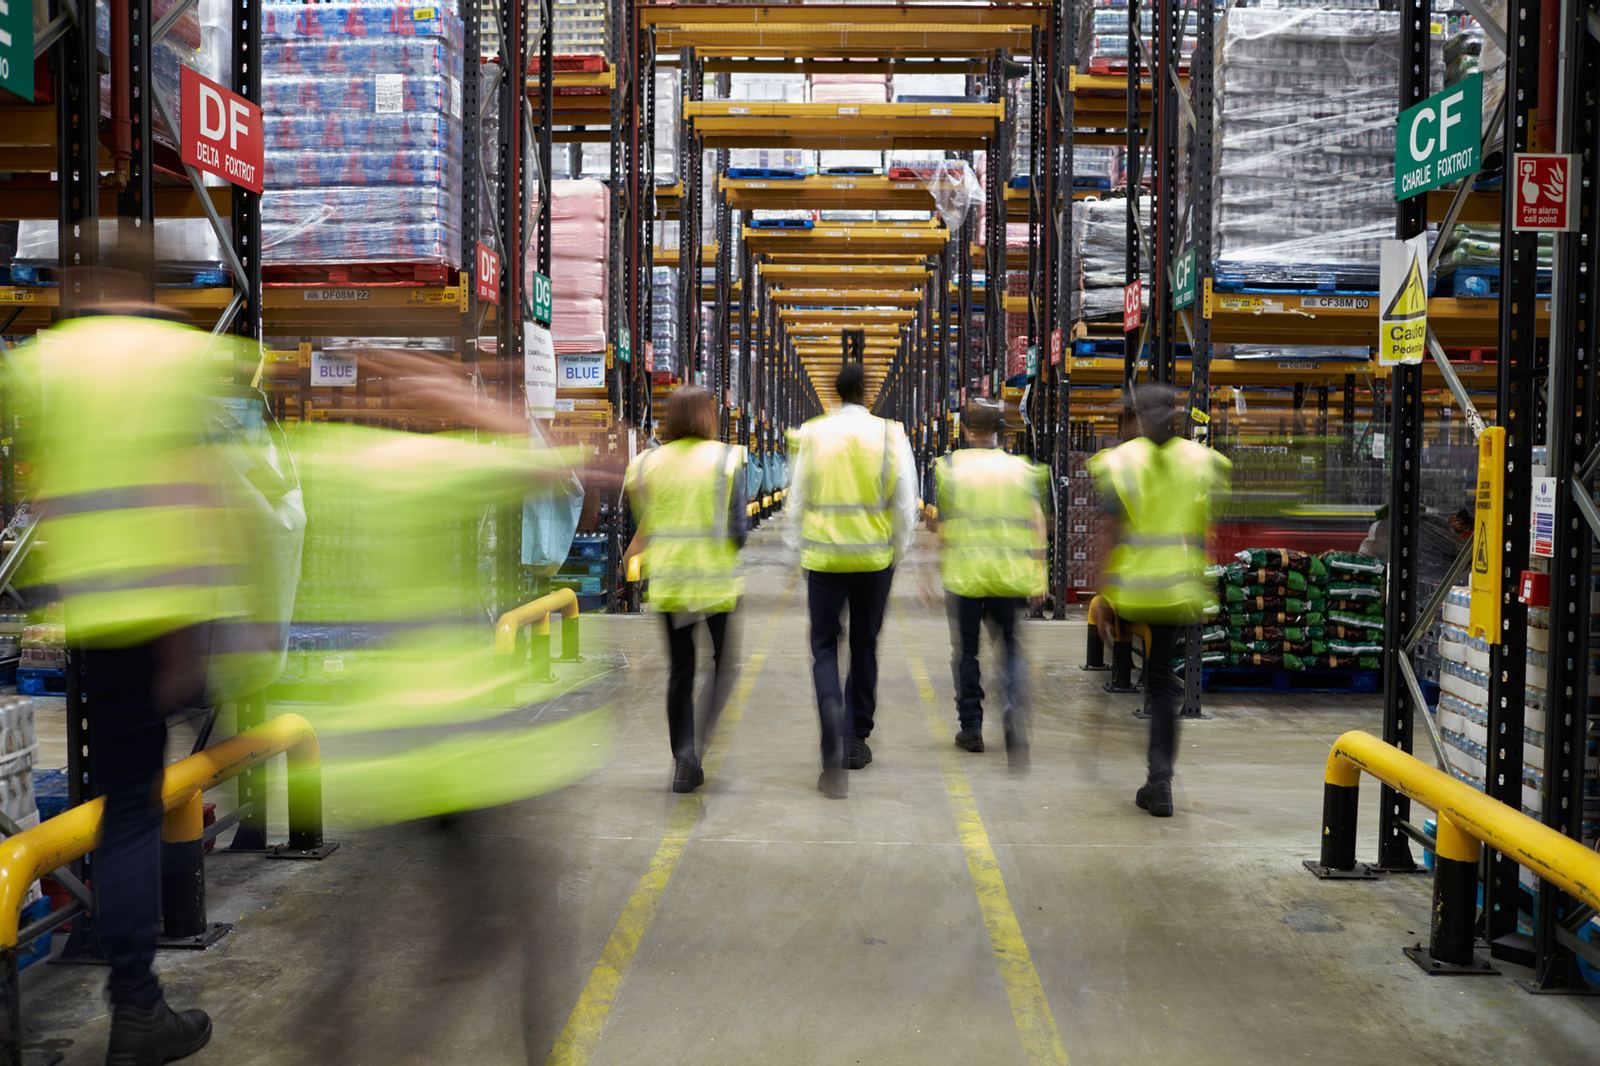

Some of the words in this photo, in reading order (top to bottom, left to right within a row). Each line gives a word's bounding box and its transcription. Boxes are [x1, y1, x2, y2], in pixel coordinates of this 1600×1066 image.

[199, 82, 250, 151] DF
[1409, 90, 1464, 162] CF
[197, 141, 220, 168] DELTA
[225, 154, 256, 184] FOXTROT
[1401, 164, 1431, 193] CHARLIE
[1437, 147, 1473, 180] FOXTROT
[1523, 206, 1537, 214] Fire
[1538, 206, 1559, 214] alarm
[1524, 215, 1537, 223] call
[1538, 215, 1557, 225] point
[481, 250, 496, 285] DF
[1176, 254, 1191, 290] CF
[322, 290, 355, 299] DF08M
[535, 276, 550, 307] DG
[1126, 283, 1139, 314] CG
[1320, 299, 1354, 307] CF38M
[619, 327, 630, 351] DG
[320, 365, 353, 377] BLUE
[566, 367, 599, 379] BLUE
[580, 356, 601, 364] Storage
